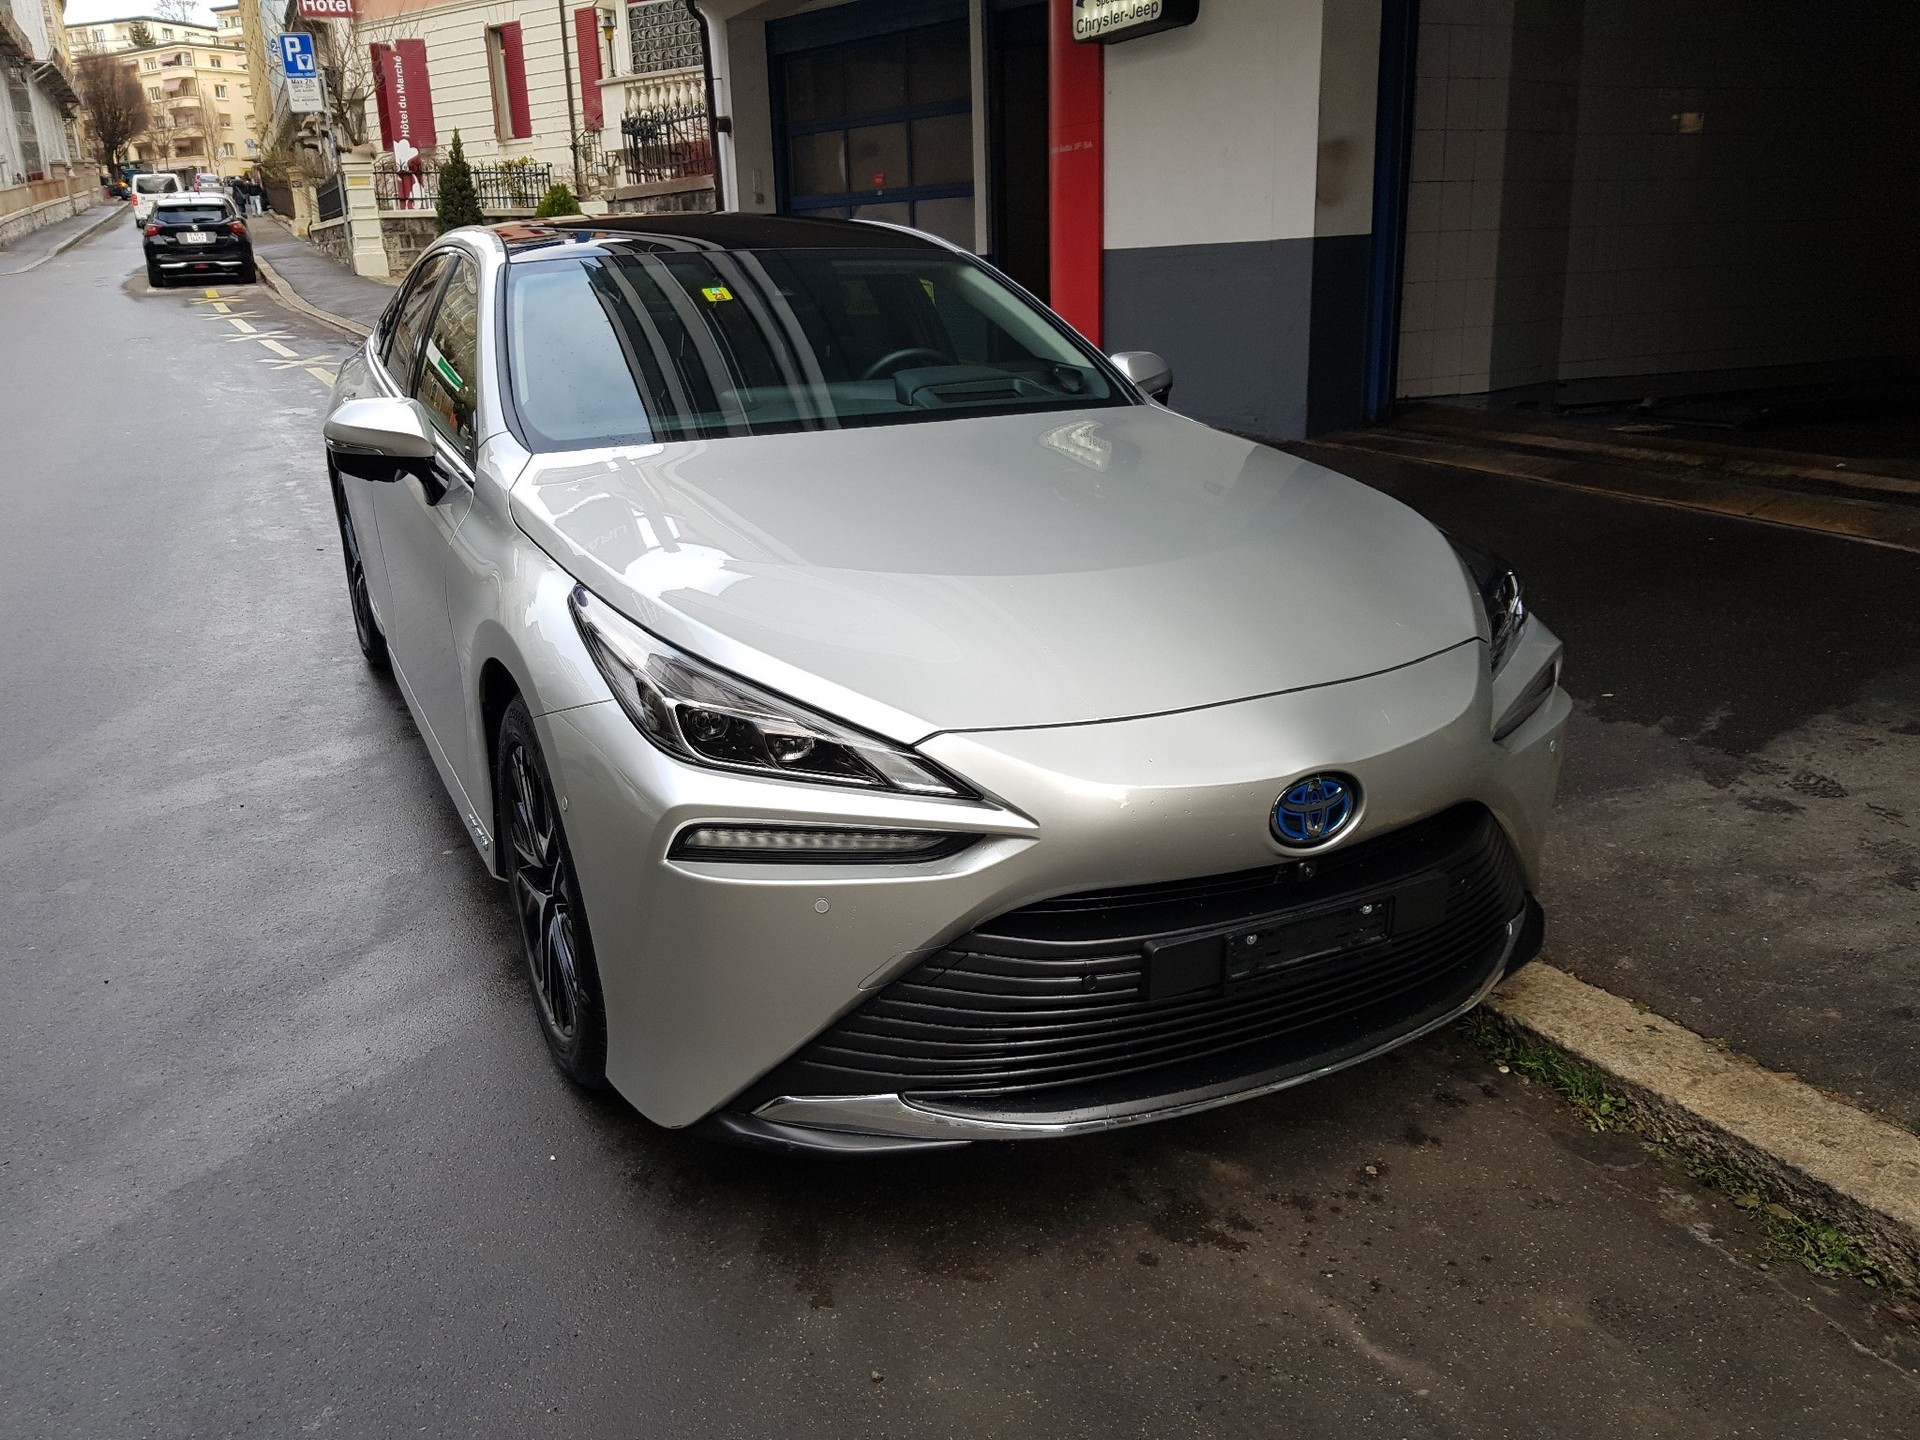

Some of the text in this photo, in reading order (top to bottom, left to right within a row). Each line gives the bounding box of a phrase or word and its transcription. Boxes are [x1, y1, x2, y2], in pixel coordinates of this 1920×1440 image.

[1076, 1, 1159, 33] Chrysler-Jeep
[284, 36, 301, 62] P
[393, 55, 410, 137] Hôtel du Marché
